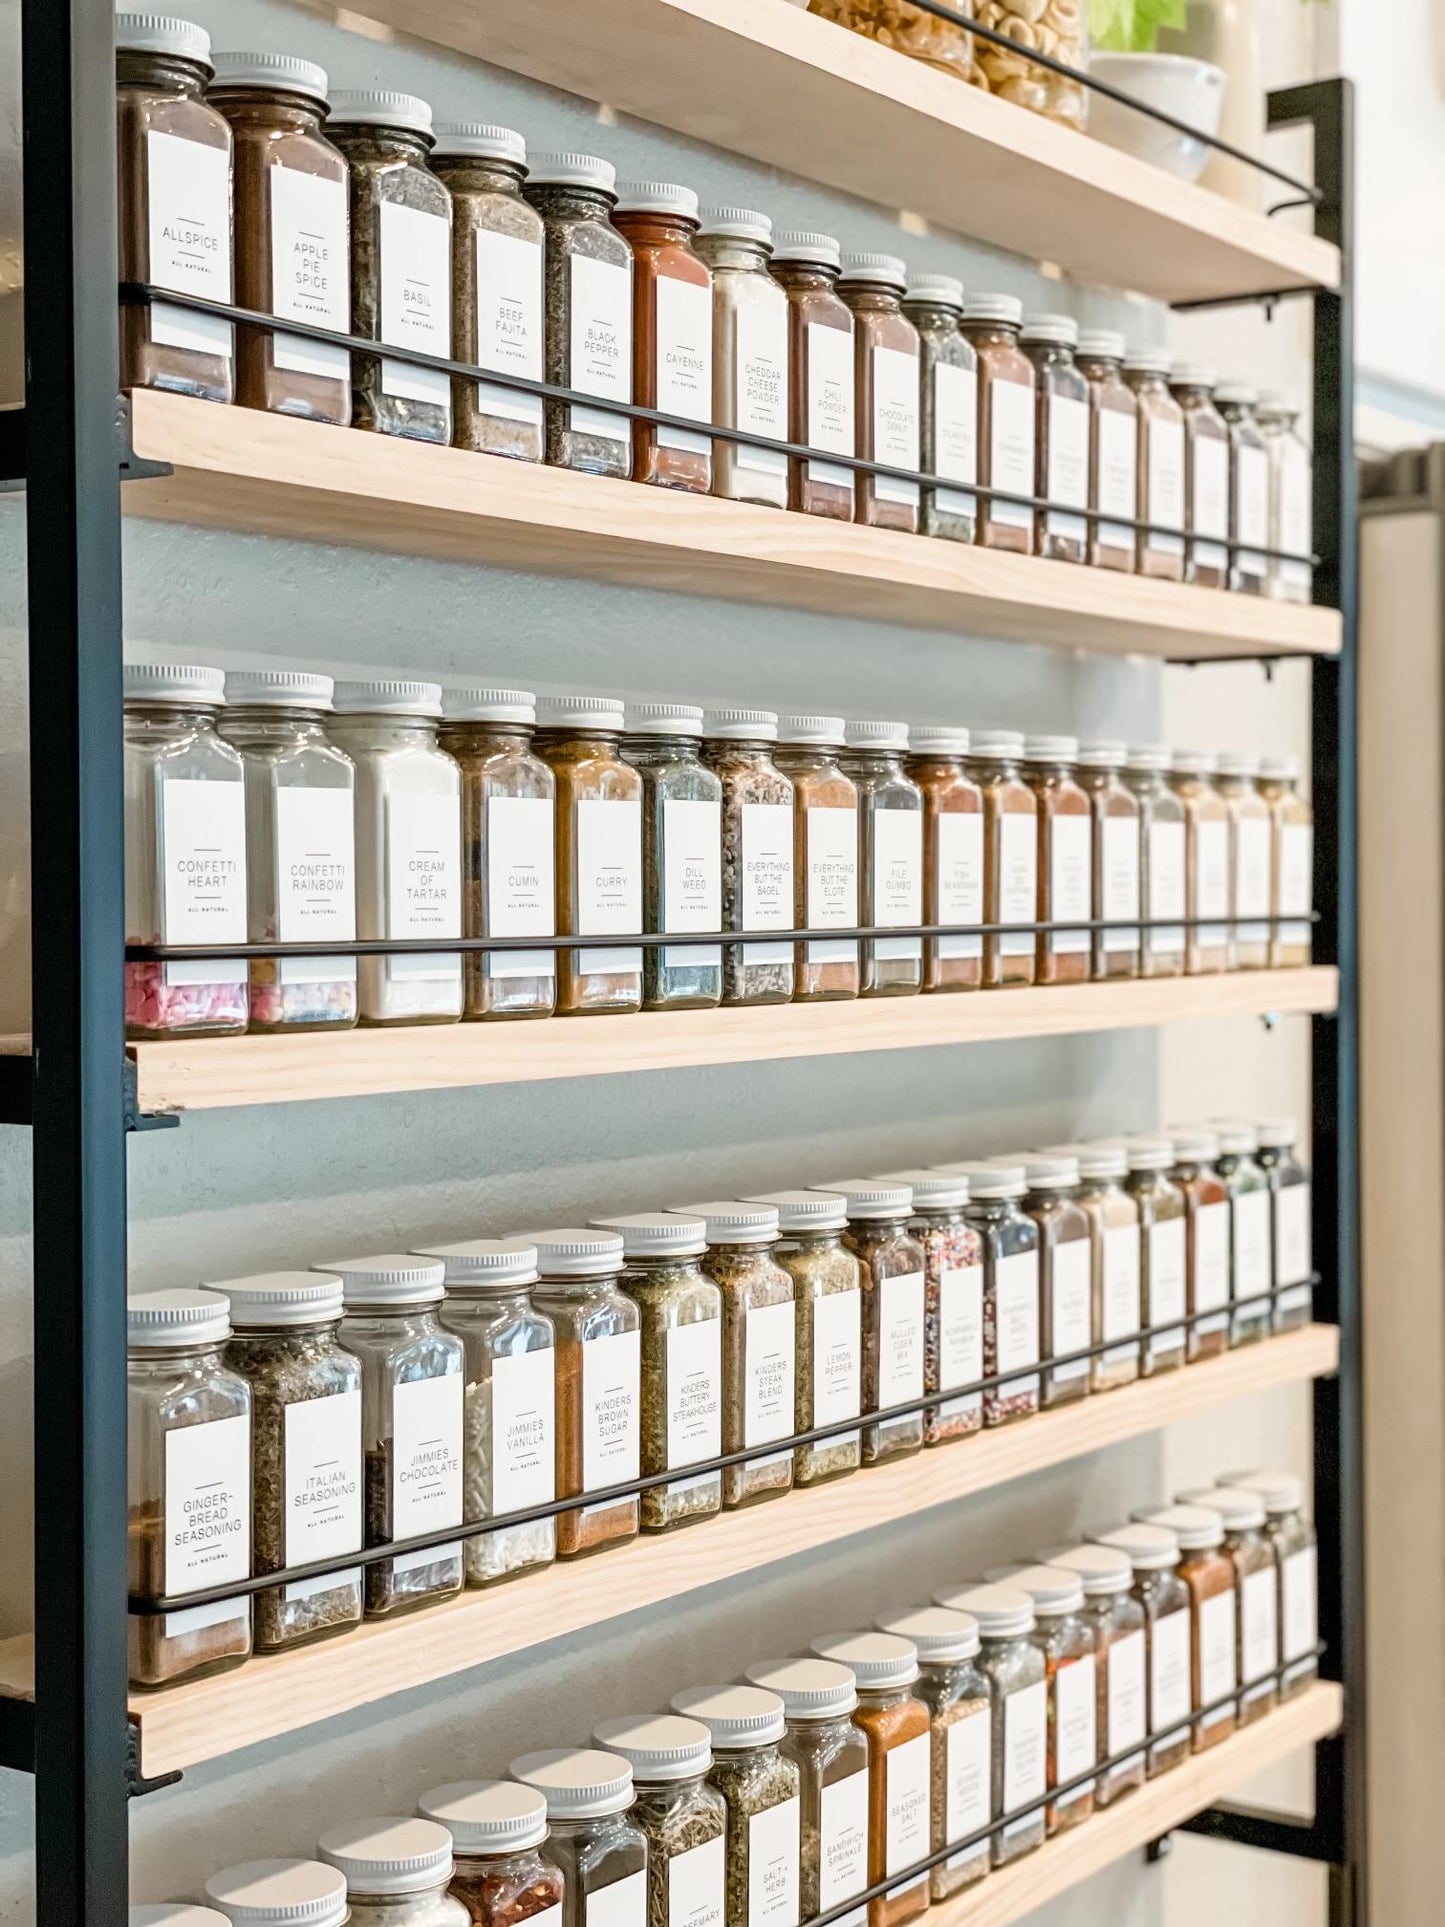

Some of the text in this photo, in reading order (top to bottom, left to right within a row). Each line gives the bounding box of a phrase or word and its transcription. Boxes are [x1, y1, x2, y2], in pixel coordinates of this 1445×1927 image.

[163, 227, 218, 251] ALLSPICE
[294, 242, 329, 261] APPLE
[185, 263, 211, 274] NATURAL
[303, 259, 320, 273] PIE
[295, 272, 328, 290] SPICE
[403, 289, 431, 307] BASIL
[305, 304, 330, 314] NATURAL
[499, 307, 524, 322] BEEF
[495, 320, 527, 337] FAJITA
[588, 328, 616, 344] BLACK
[584, 341, 619, 359] PEPPER
[666, 352, 704, 371] CAYENNE
[745, 364, 781, 381] CHEDDAR
[748, 377, 778, 392] CHEESE
[747, 389, 779, 405] POWDER
[824, 389, 842, 401] CHILI
[818, 399, 847, 414] POWDER
[879, 408, 914, 424] CHOCOLATE
[177, 860, 236, 873] CONFETTI
[290, 864, 345, 876] CONFETTI
[409, 860, 445, 872] CREAM
[685, 867, 703, 877] DILL
[747, 862, 790, 872] EVERYTHING
[813, 863, 854, 874] EVERYTHING
[188, 875, 227, 888] HEART
[292, 879, 344, 891] RAINBOW
[420, 874, 434, 885] OF
[508, 875, 539, 887] CUMIN
[596, 876, 627, 887] CURRY
[682, 879, 706, 890] WEED
[754, 874, 783, 884] BUT THE
[821, 875, 848, 885] BUT THE
[886, 880, 911, 890] GUMBO
[407, 888, 447, 900] TARTAR
[757, 885, 780, 896] BAGEL
[824, 886, 846, 897] ELOTE
[827, 1351, 851, 1366] LEMON
[755, 1360, 787, 1376] KINDERS
[825, 1362, 852, 1377] PEPPER
[680, 1379, 710, 1395] KINDERS
[759, 1375, 783, 1388] STEAK
[758, 1385, 783, 1399] BLEND
[595, 1394, 632, 1412] KINDERS
[680, 1392, 711, 1408] BUTTERY
[598, 1409, 629, 1425] BROWN
[672, 1402, 717, 1422] STEAKHOUSE
[506, 1419, 544, 1437] JIMMIES
[599, 1420, 628, 1437] SUGAR
[506, 1432, 544, 1451] VANILLA
[410, 1448, 449, 1467] JIMMIES
[400, 1459, 459, 1483] CHOCOLATE
[306, 1470, 346, 1489] ITALIAN
[183, 1492, 234, 1513] GINGER-
[294, 1482, 356, 1508] SEASONING
[423, 1491, 447, 1500] NATURAL
[189, 1507, 228, 1527] BREAD
[320, 1514, 345, 1525] NATURAL
[174, 1519, 242, 1546] SEASONING
[200, 1553, 229, 1564] NATURAL
[891, 1793, 926, 1817] SEASONED
[901, 1809, 918, 1824] SALT
[826, 1832, 864, 1857] SANDWICH
[828, 1842, 862, 1868] SPRINKLE
[763, 1867, 783, 1884] SALT
[765, 1877, 786, 1894] HERB
